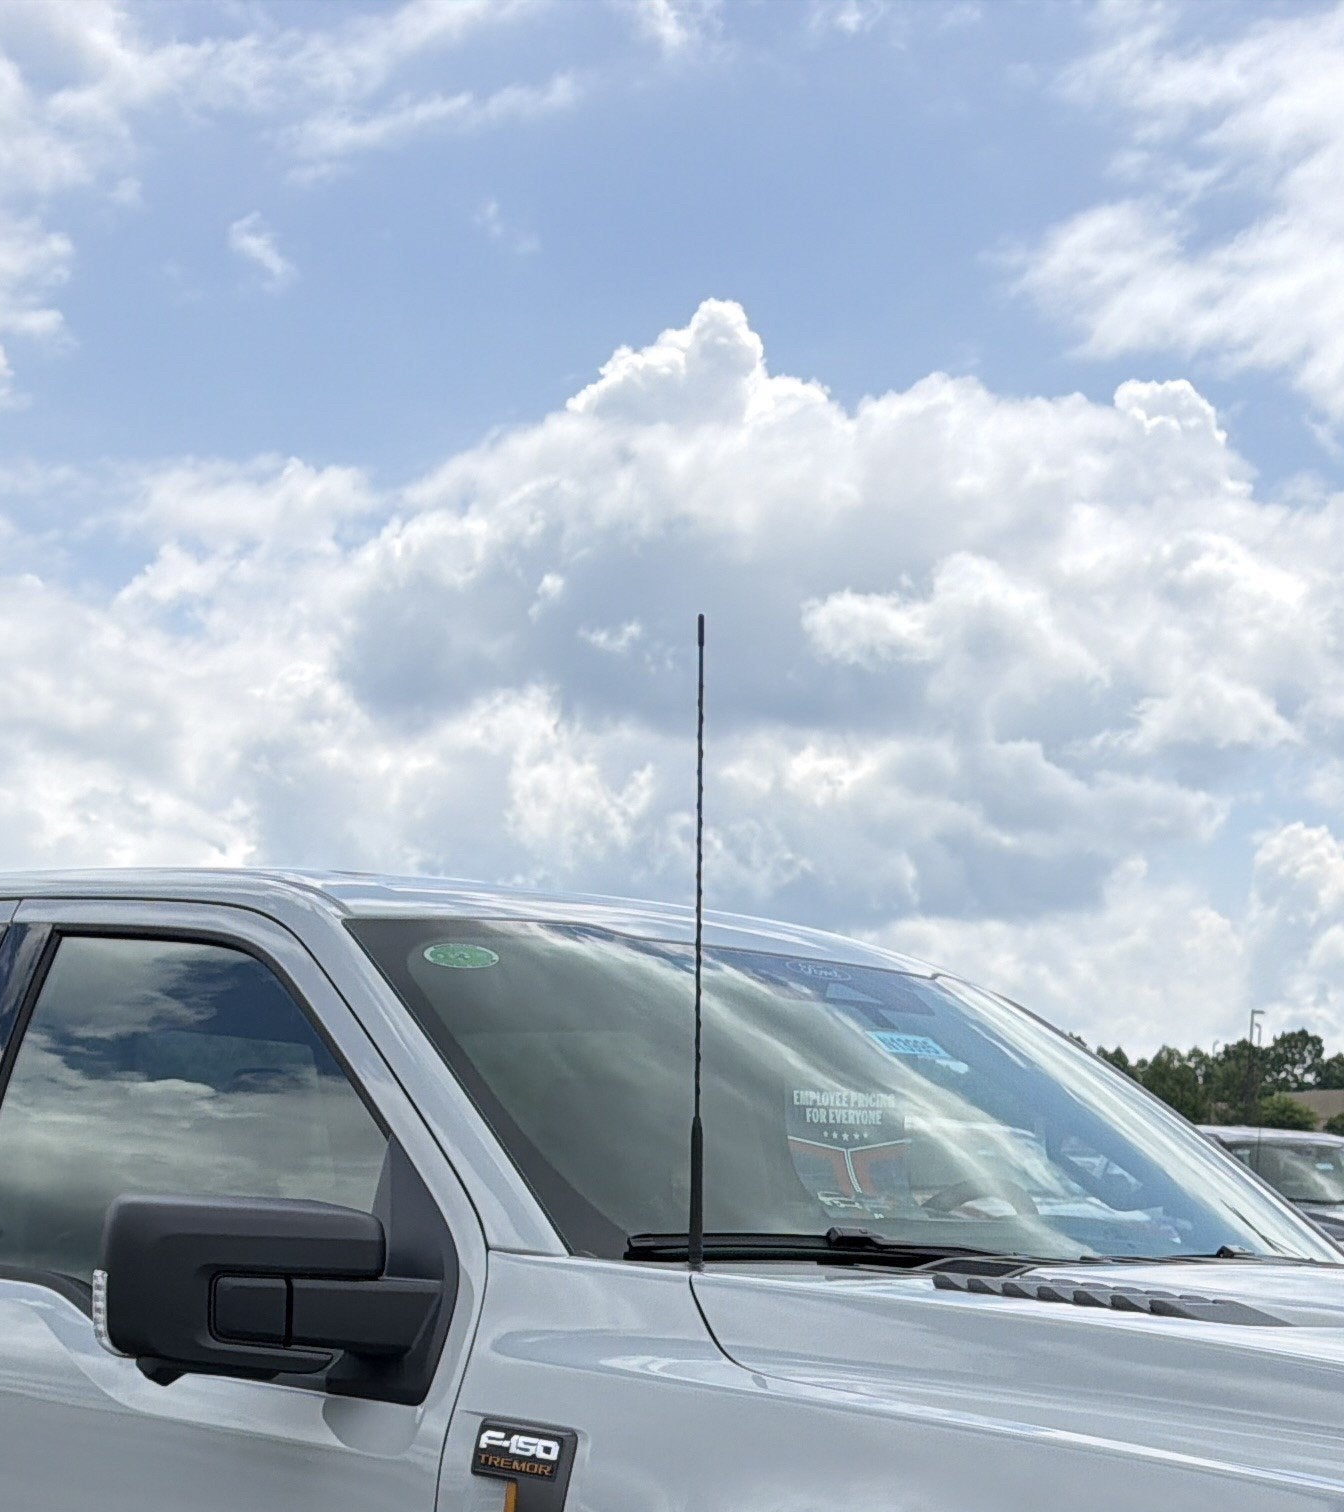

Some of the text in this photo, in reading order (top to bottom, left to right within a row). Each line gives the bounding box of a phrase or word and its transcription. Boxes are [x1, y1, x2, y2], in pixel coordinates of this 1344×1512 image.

[793, 1090, 896, 1108] EMPLOYEE PRICING
[805, 1107, 883, 1125] FOR EVERYONE
[478, 1429, 560, 1461] F-150
[478, 1453, 553, 1477] TREMOR
